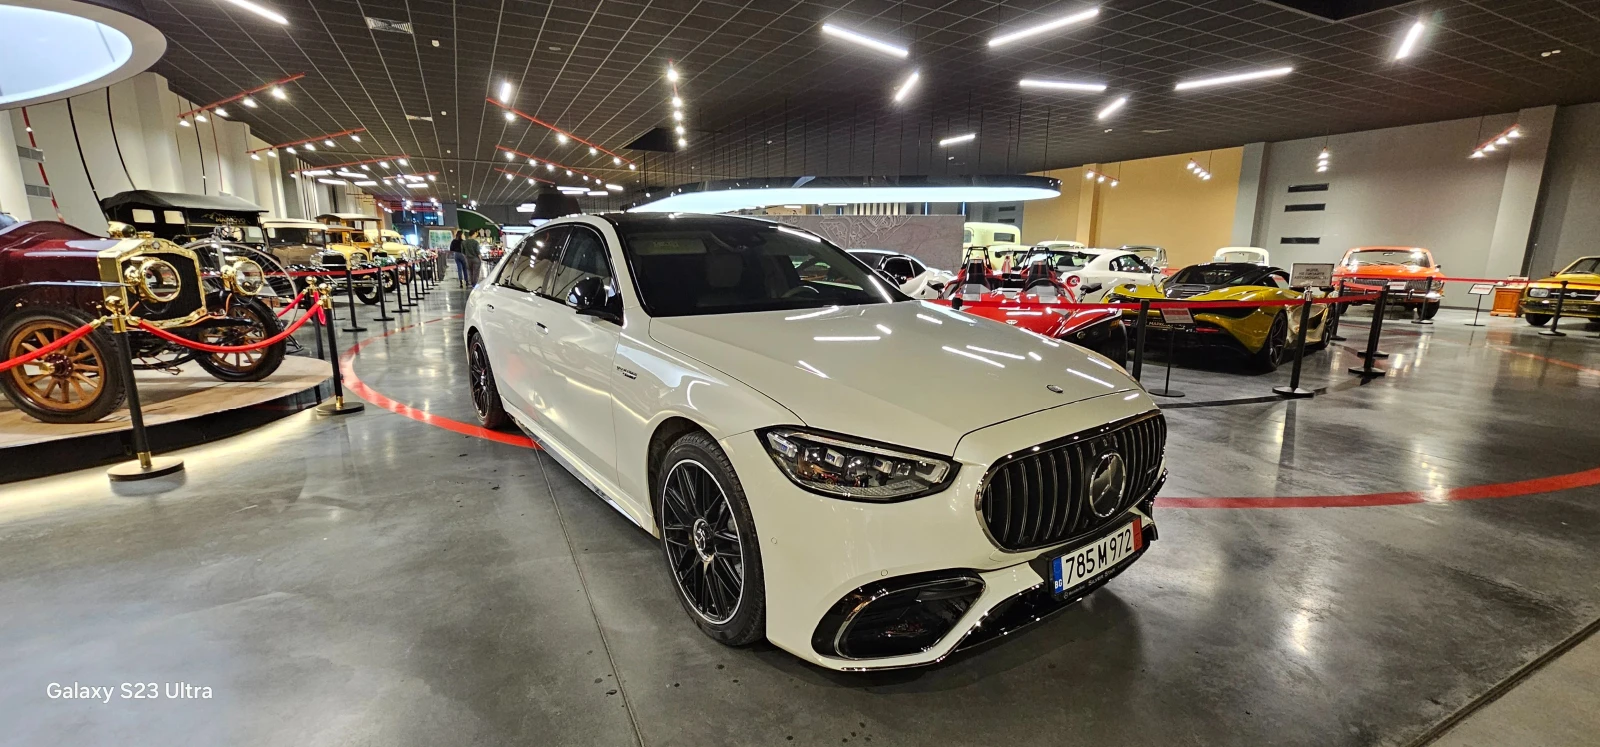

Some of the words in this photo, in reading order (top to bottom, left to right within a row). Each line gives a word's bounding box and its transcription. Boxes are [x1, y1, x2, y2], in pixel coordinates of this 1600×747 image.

[1066, 548, 1095, 584] 785
[1098, 542, 1107, 568] M
[1110, 528, 1132, 561] 972
[1054, 578, 1063, 589] BG
